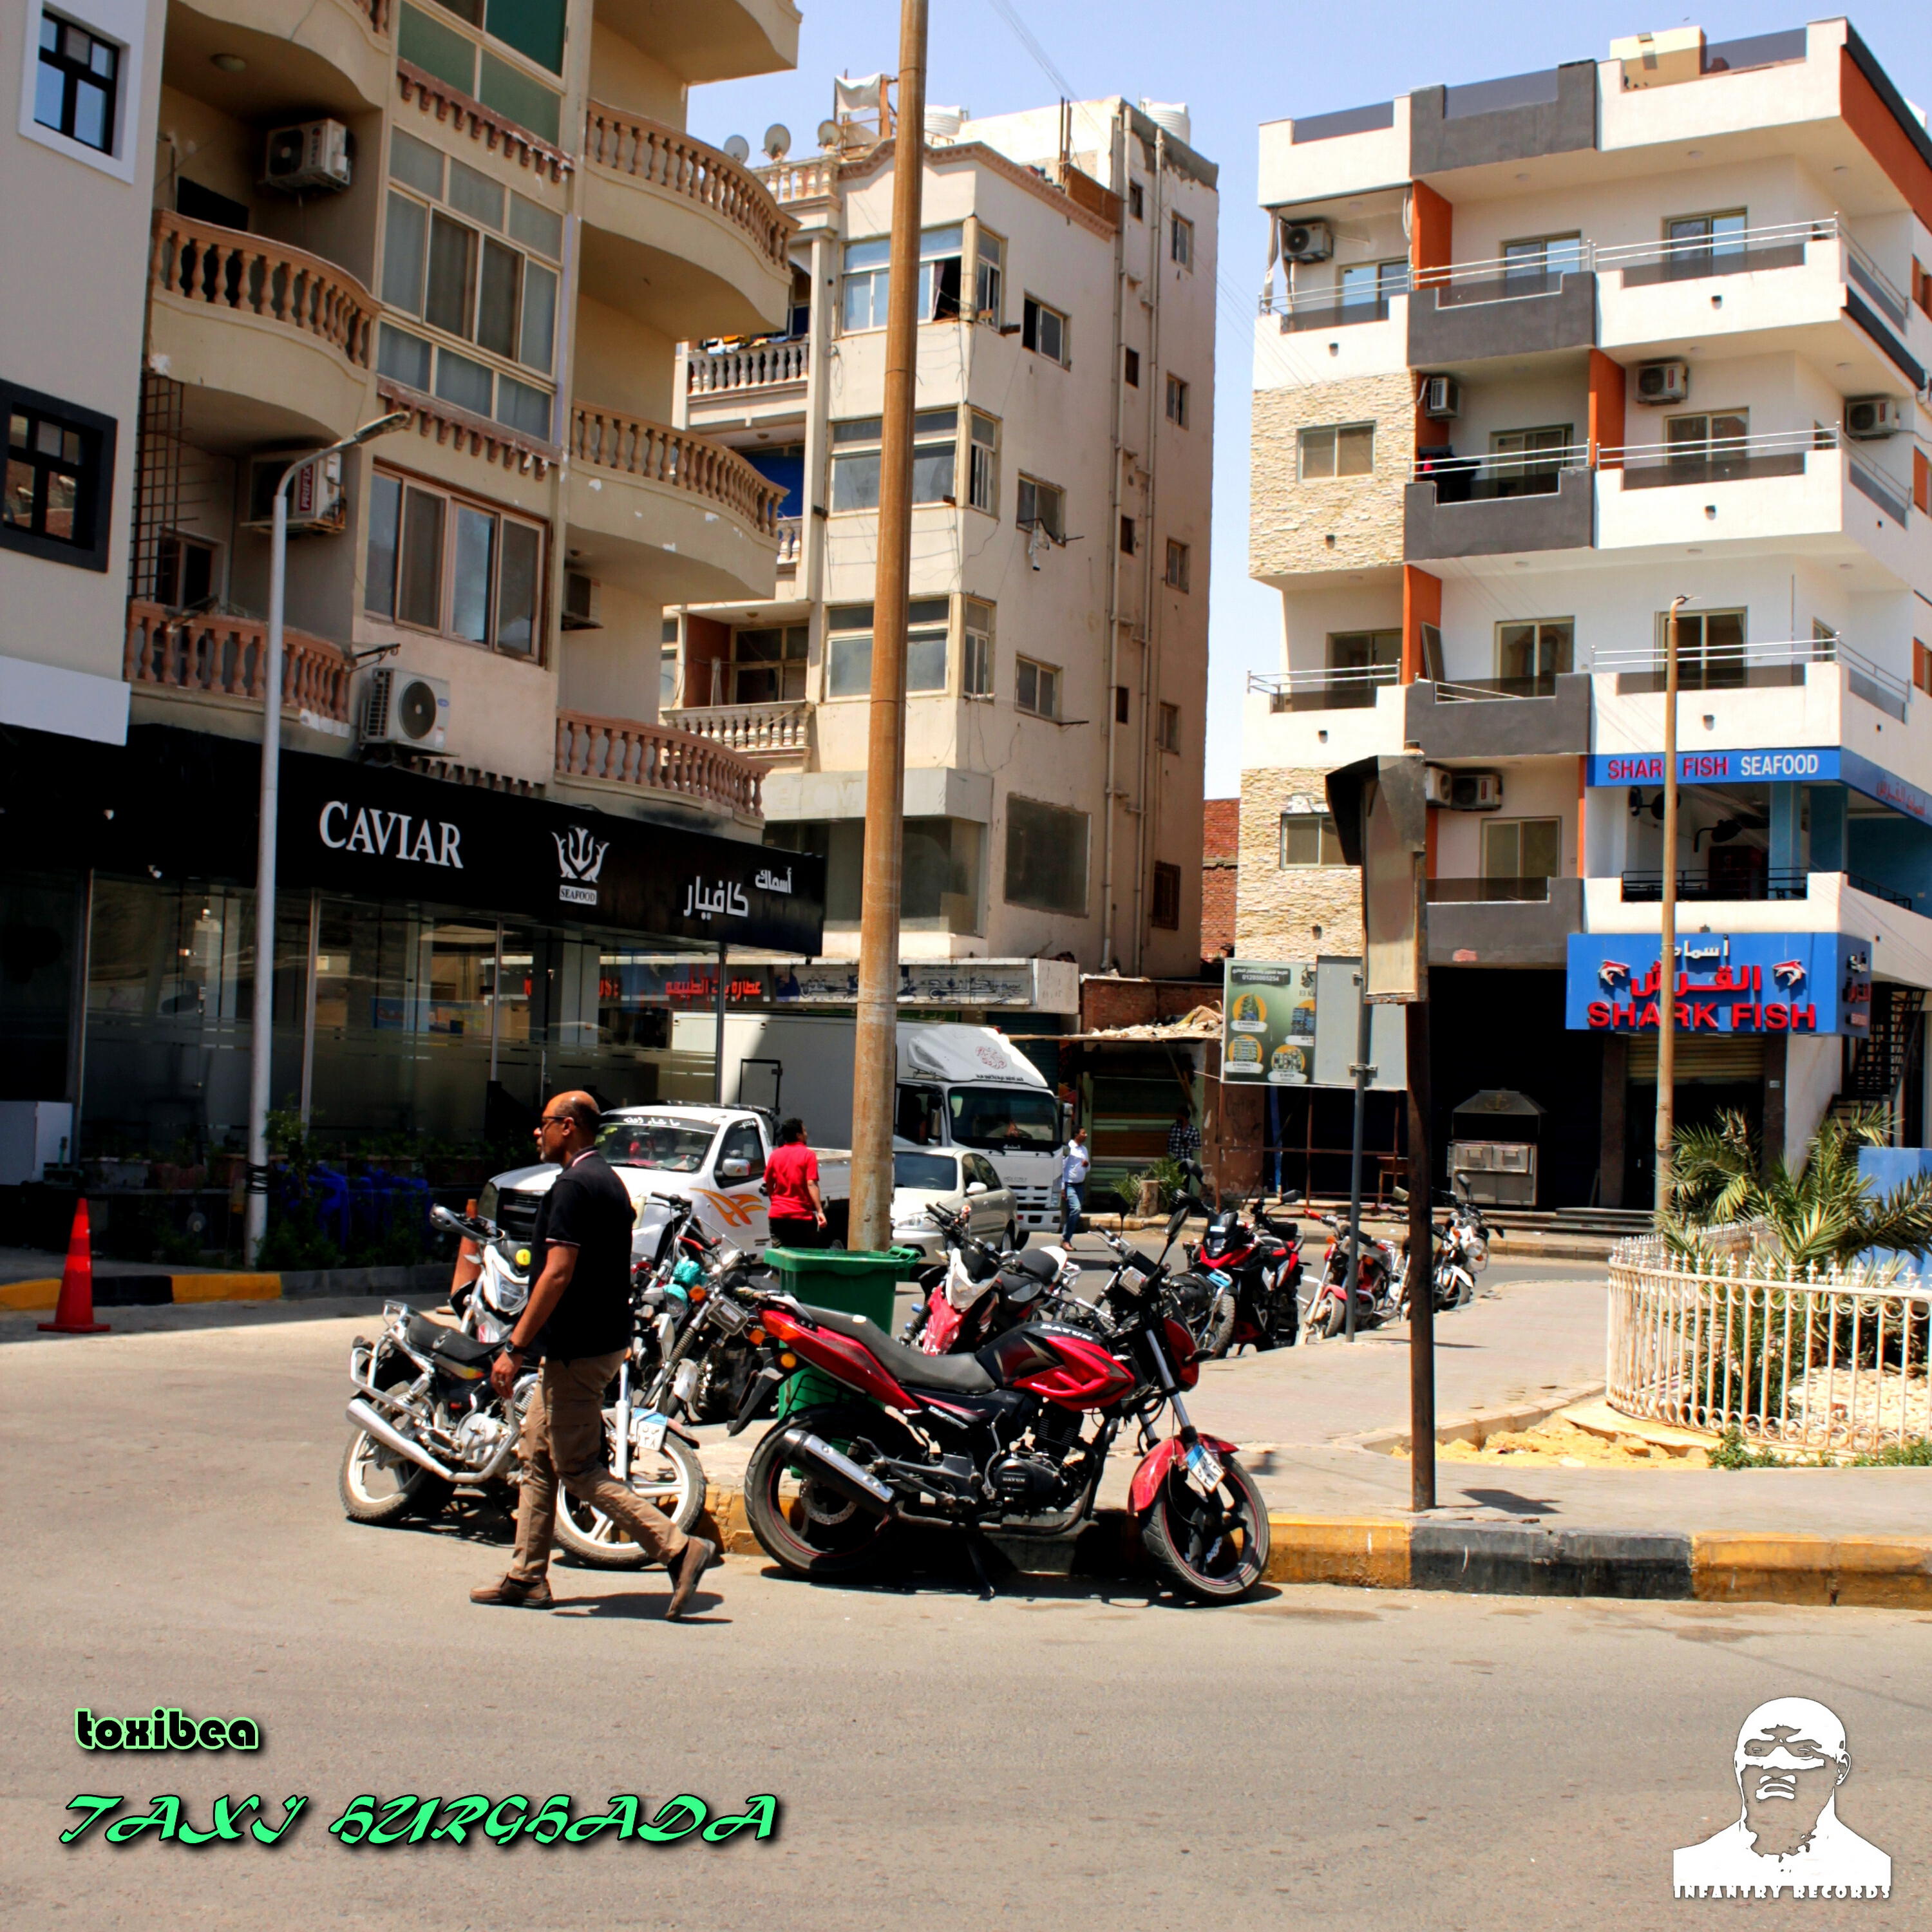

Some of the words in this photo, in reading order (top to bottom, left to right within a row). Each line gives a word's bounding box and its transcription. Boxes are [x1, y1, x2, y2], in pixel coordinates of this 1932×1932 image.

[1608, 759, 1676, 780] SHAR
[1683, 757, 1728, 777] FISH
[1741, 754, 1819, 776] SEAFOOD
[319, 800, 464, 869] CAVIAR
[755, 867, 792, 894] أسماك
[561, 887, 596, 902] SEAFOOD
[683, 876, 749, 921] كافيار
[1630, 960, 1761, 997] القرش
[1587, 1001, 1718, 1028] SHARK
[1731, 1003, 1816, 1028] FISH
[1039, 1323, 1094, 1341] DAYUN
